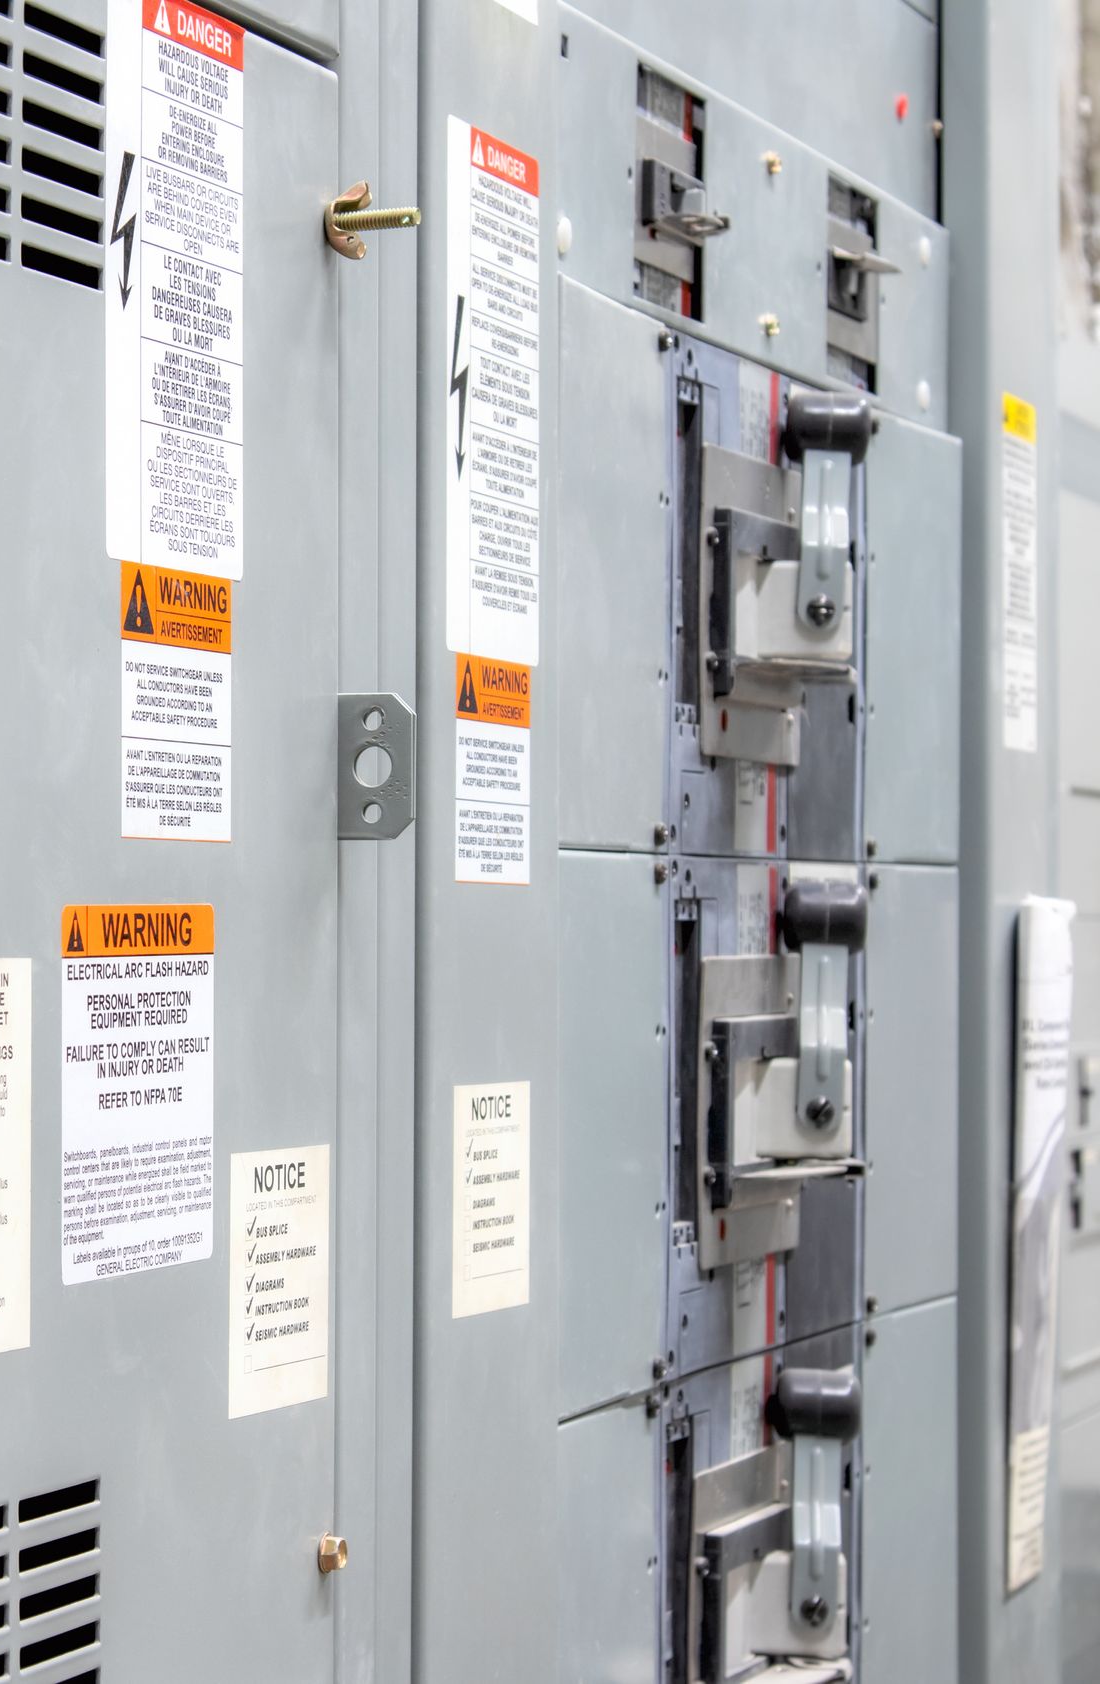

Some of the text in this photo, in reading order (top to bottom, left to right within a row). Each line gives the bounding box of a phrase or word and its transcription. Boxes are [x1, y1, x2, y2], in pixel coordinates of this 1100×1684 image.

[178, 10, 232, 57] DANGER
[159, 40, 228, 83] HAZARDOUS VOLTAGE
[159, 57, 228, 100] WILL CAUSE SERIOUS
[165, 77, 222, 114] INJURY OR DEATH
[169, 105, 218, 136] DE-ENERGIZE ALL
[172, 121, 215, 150] POWER BEFORE
[162, 132, 224, 168] ENTERING ENCLOSURE
[158, 145, 228, 183] OR REMOVING BARRIERS
[488, 146, 526, 182] DANGER
[164, 255, 222, 286] LE CONTACT AVEC
[170, 274, 216, 302] LES TENSIONS
[152, 286, 232, 324] DANGEREUSES CAUSERA
[154, 304, 230, 340] DE GRAVES BLESSURES
[172, 327, 213, 352] OU LA MORT
[159, 576, 227, 614] WARNING
[161, 620, 222, 644] AVERTISSEMENT
[126, 661, 223, 683] DO NOT SERVICE SWITCHGEAR UNLESS
[482, 666, 528, 695] WARNING
[137, 679, 212, 697] ALL CONDUCTORS HAVE BEEN
[137, 694, 213, 713] GROUNDED ACCORDING TO AN
[483, 702, 524, 720] AVERTISSEMENT
[131, 710, 218, 729] ACCEPTABLE SAFETY PROCEDURE
[102, 913, 192, 948] WARNING
[1, 973, 9, 987] IN
[67, 960, 209, 981] ELECTRICAL ARC FLASH HAZARD
[87, 991, 191, 1011] PERSONAL PROTECTION
[91, 1008, 187, 1029] EQUIPMENT REQUIRED
[66, 1037, 210, 1063] FAILURE TO COMPLY CAN RESULT
[97, 1056, 184, 1079] IN INJURY OR DEATH
[99, 1086, 182, 1110] REFER TO NFPA 70E
[472, 1095, 511, 1120] NOTICE
[254, 1162, 305, 1193] NOTICE
[256, 1224, 288, 1238] BUS SPLICE
[96, 1250, 182, 1276] GENERAL ELECTRIC COMPANY
[255, 1245, 316, 1265] ASSEMBLY HARDWARE
[256, 1278, 284, 1293] DIAGRAMS
[255, 1297, 309, 1316] INSTRUCTION BOOK
[255, 1321, 309, 1342] SEISMIC HARDWARE
